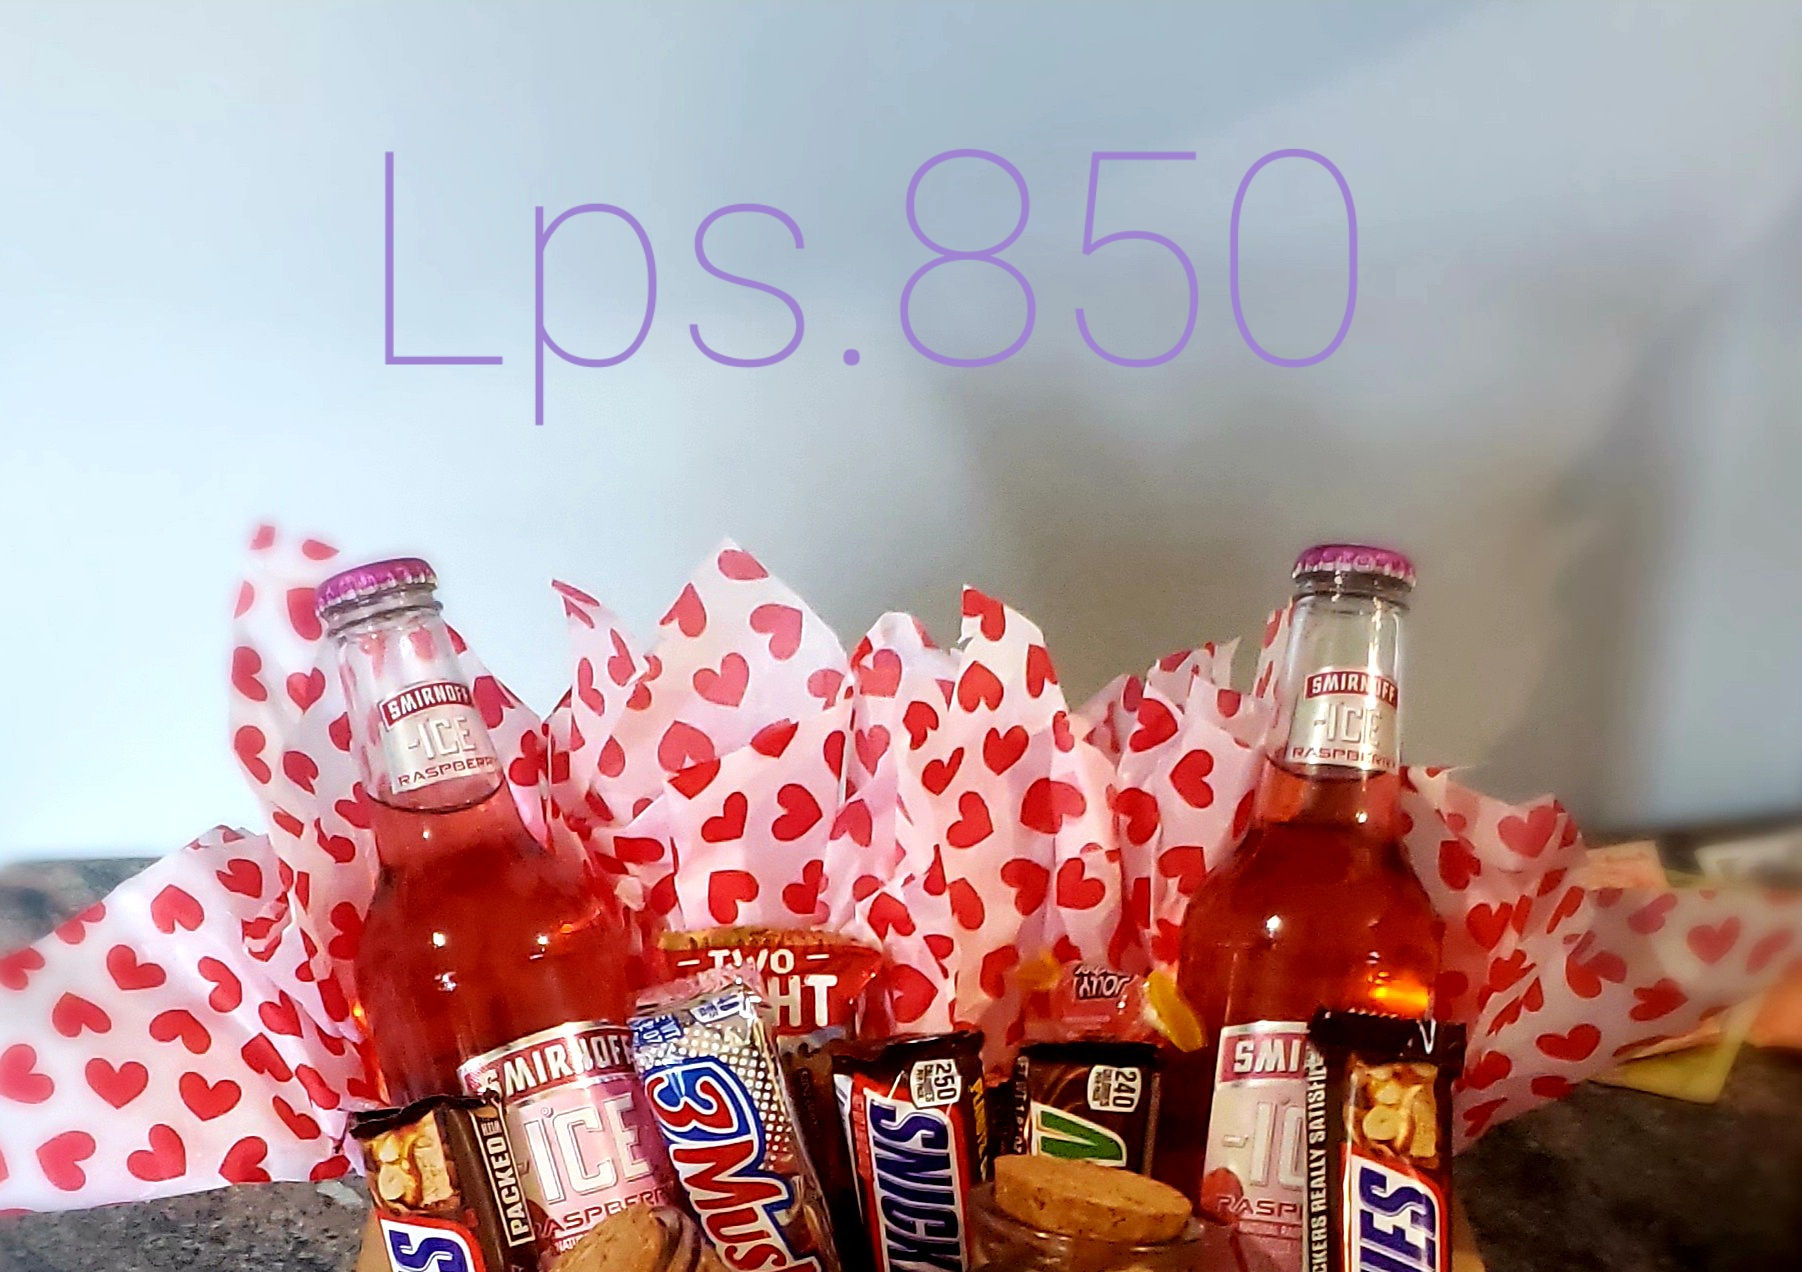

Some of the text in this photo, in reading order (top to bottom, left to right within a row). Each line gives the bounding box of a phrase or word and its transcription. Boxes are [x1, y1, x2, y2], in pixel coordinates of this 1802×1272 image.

[934, 1062, 957, 1101] 250
[1112, 1070, 1138, 1109] 240
[486, 1136, 530, 1237] PACKED
[1309, 1147, 1328, 1212] REALLY
